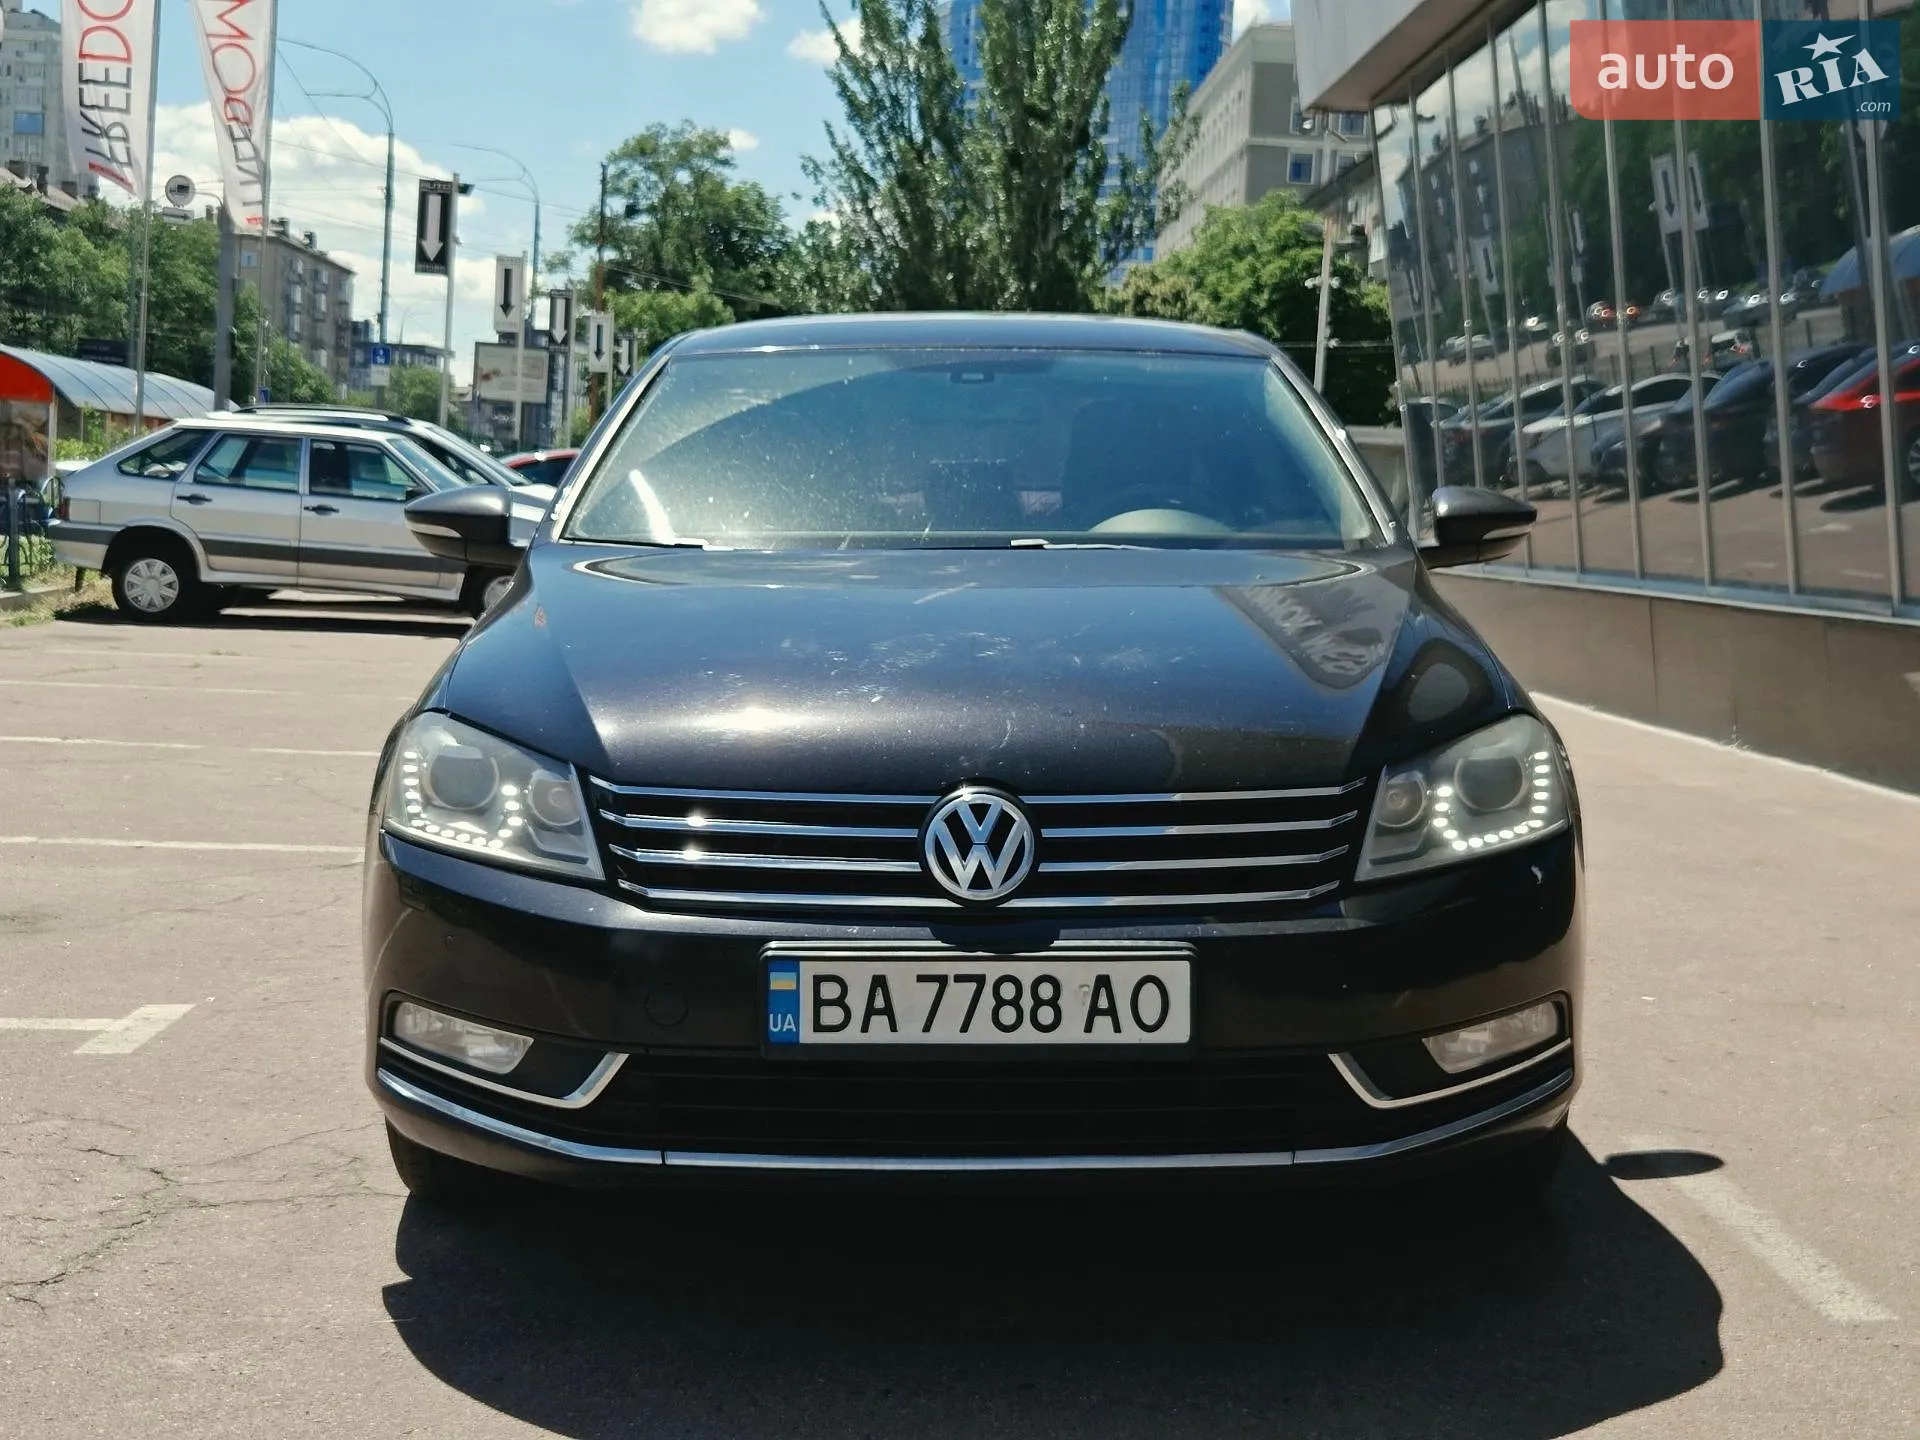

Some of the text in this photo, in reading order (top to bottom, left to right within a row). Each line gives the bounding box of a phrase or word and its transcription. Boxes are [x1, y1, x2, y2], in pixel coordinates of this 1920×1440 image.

[769, 1013, 796, 1032] UA
[812, 974, 1170, 1033] BA 7788 AO
